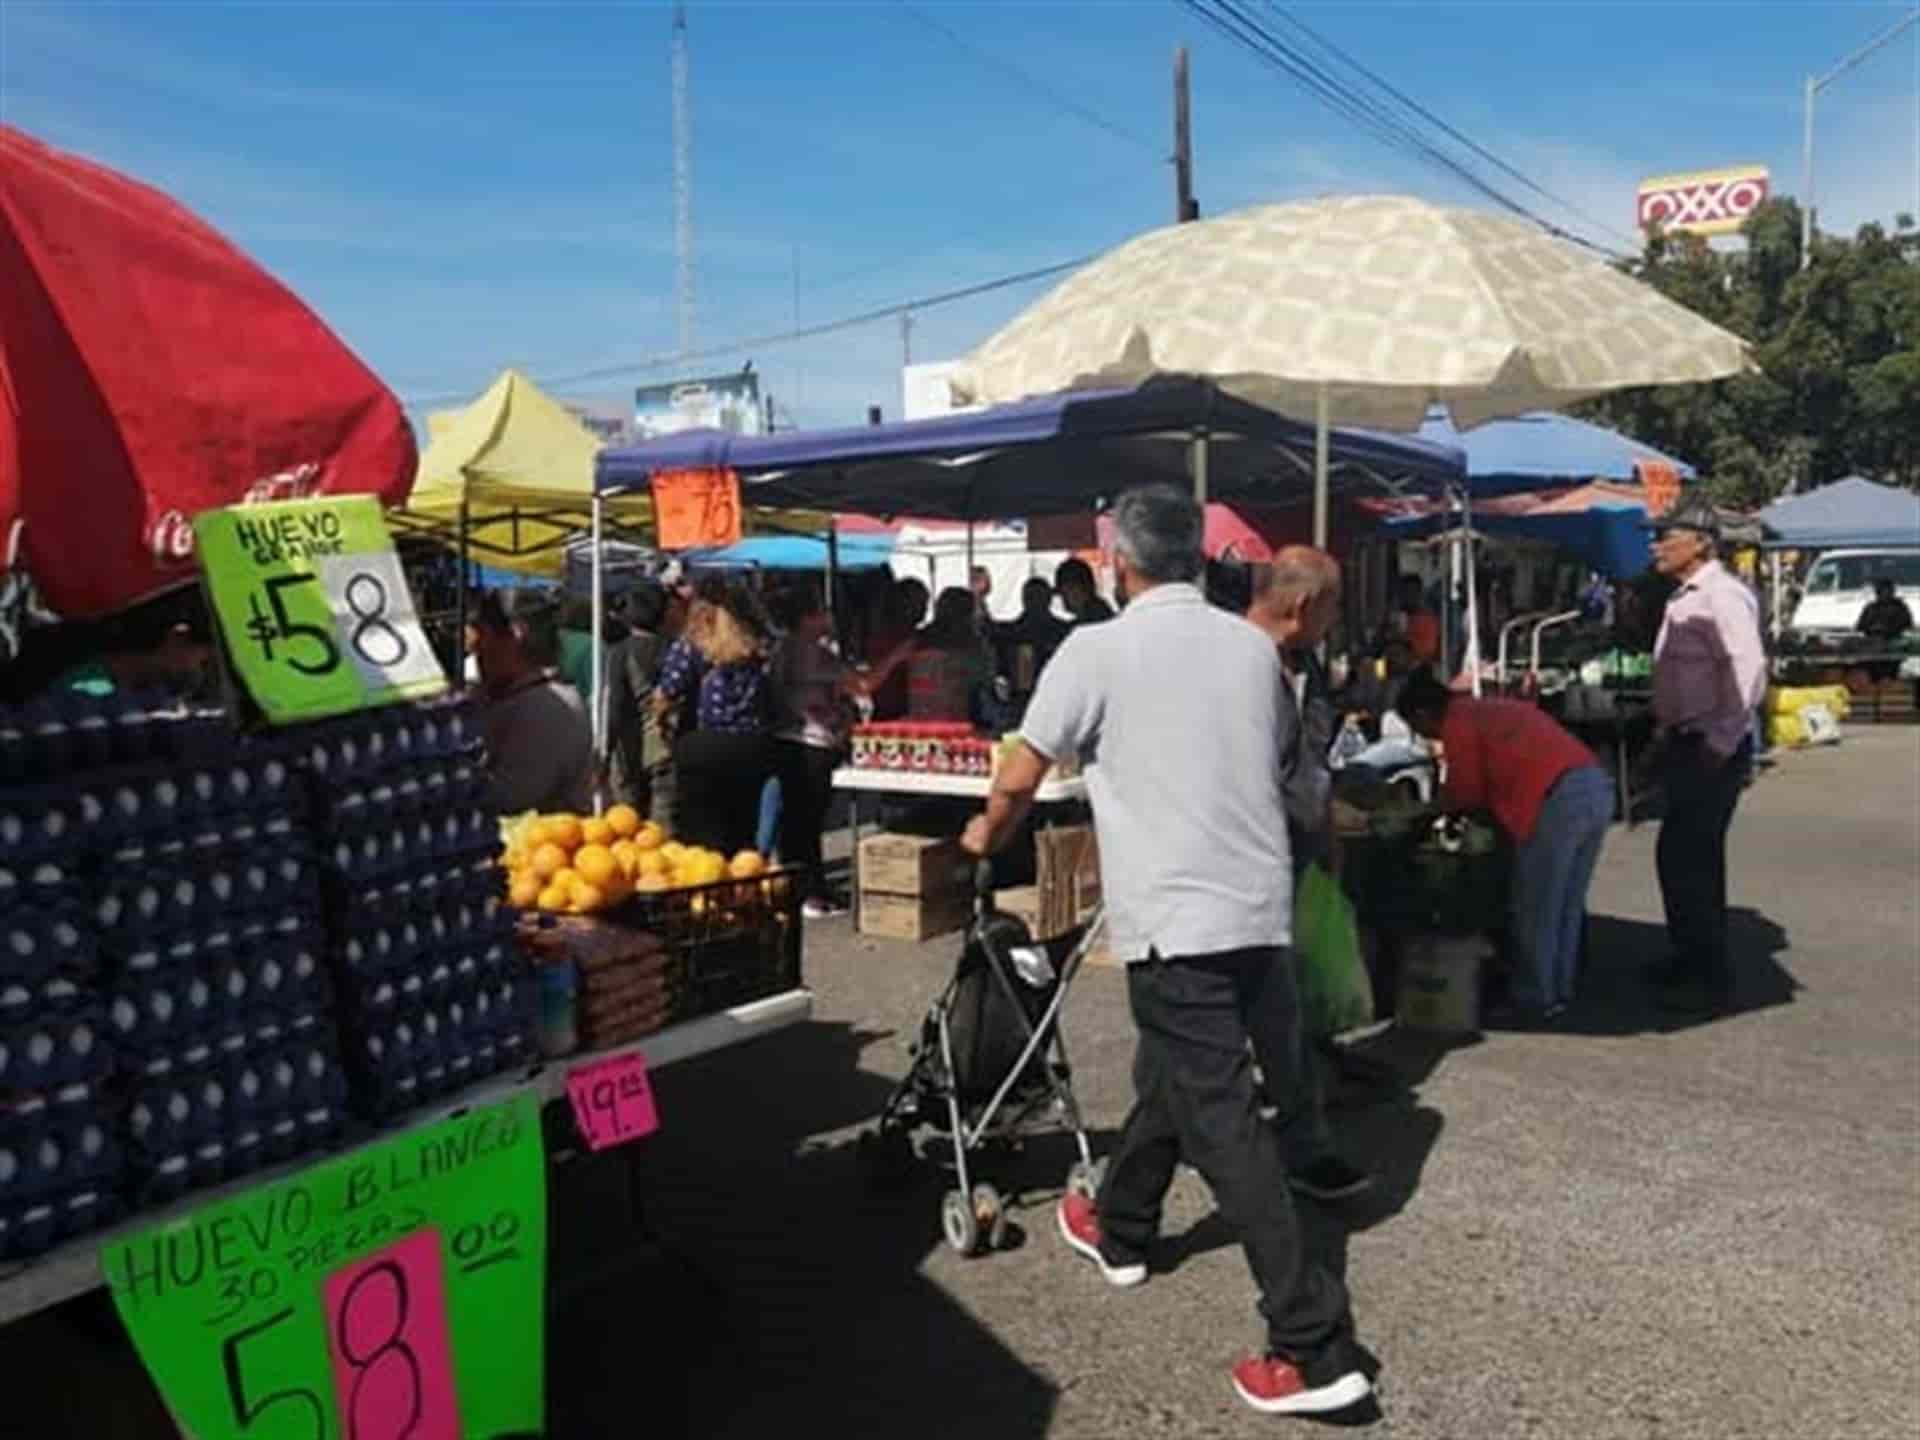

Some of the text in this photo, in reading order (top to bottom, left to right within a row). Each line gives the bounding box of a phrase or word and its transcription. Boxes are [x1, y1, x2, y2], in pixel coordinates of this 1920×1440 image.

[1642, 181, 1762, 232] OXXO
[122, 1112, 522, 1300] HUEVO BLANCO
[204, 1266, 280, 1327] 30
